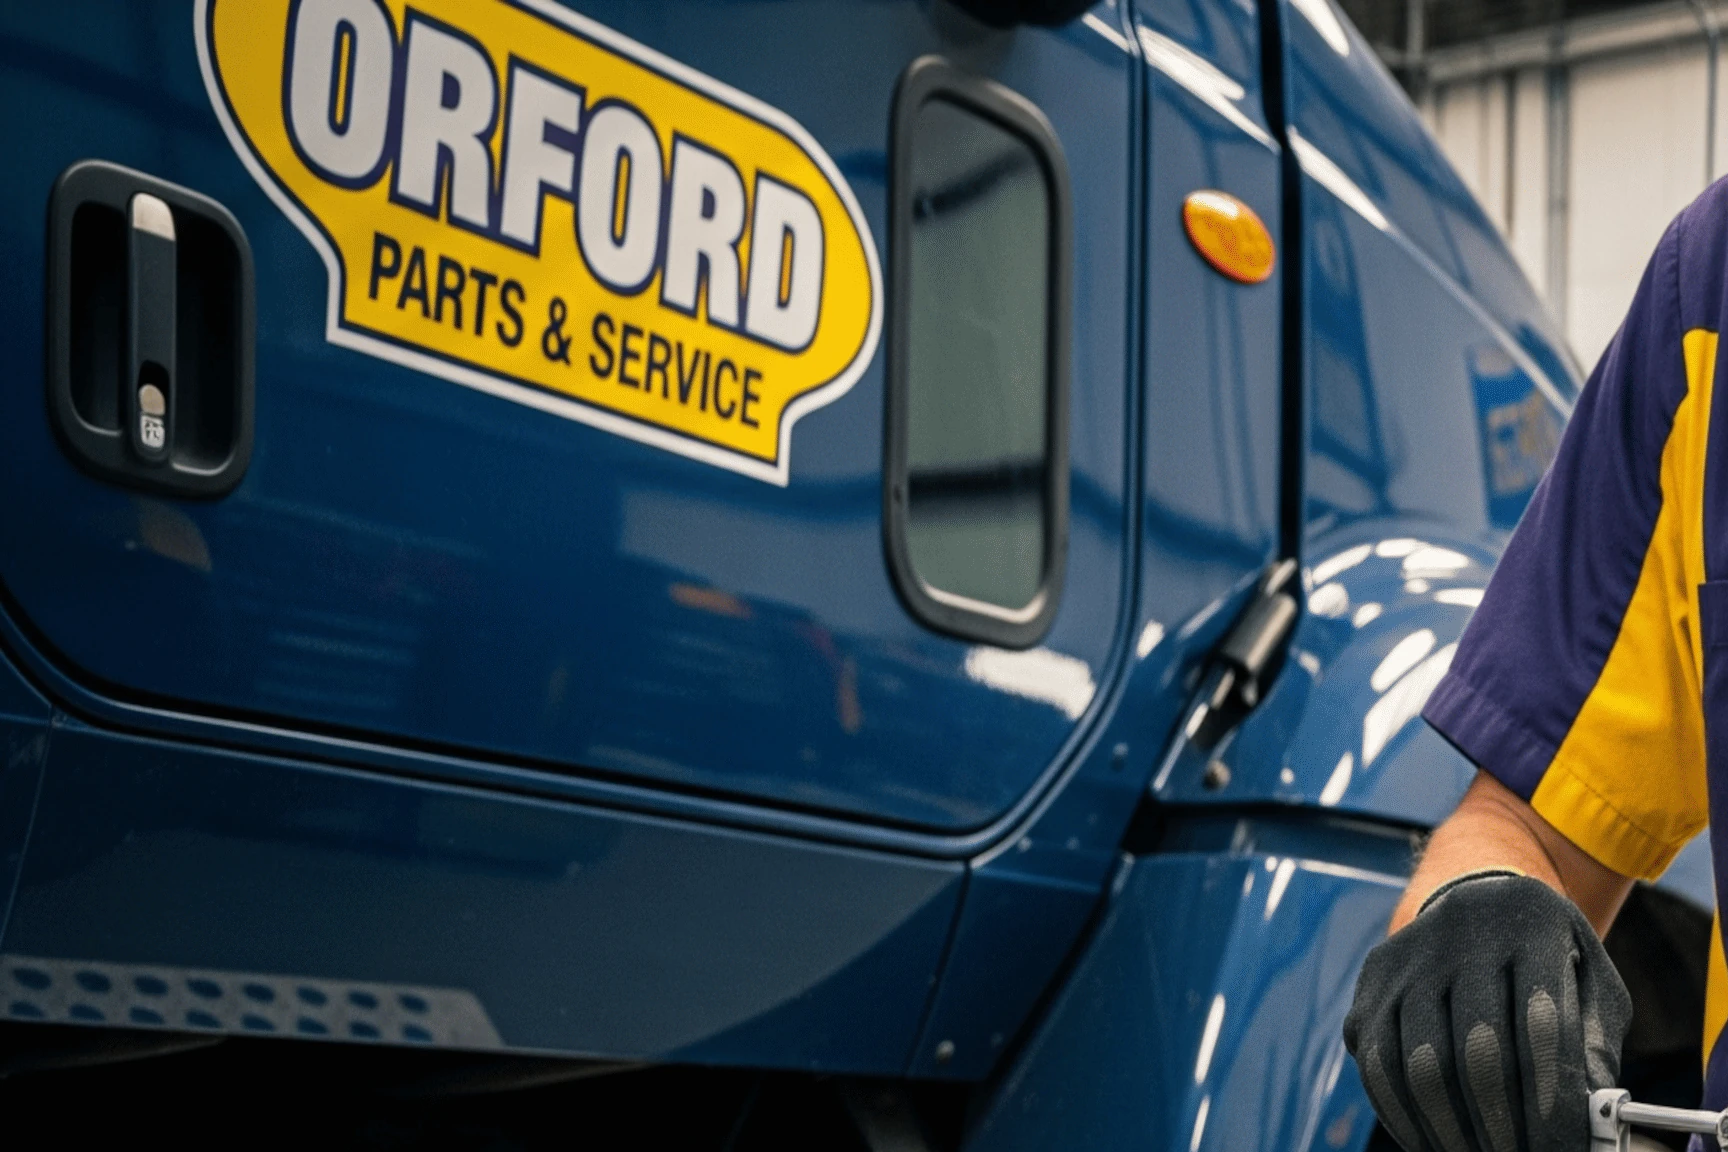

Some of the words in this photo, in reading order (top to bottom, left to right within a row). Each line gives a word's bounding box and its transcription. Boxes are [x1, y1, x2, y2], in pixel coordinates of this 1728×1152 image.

[286, 0, 826, 352] ORFORD
[368, 231, 526, 347] PARTS
[540, 296, 572, 367] &
[589, 312, 763, 429] SERVICE
